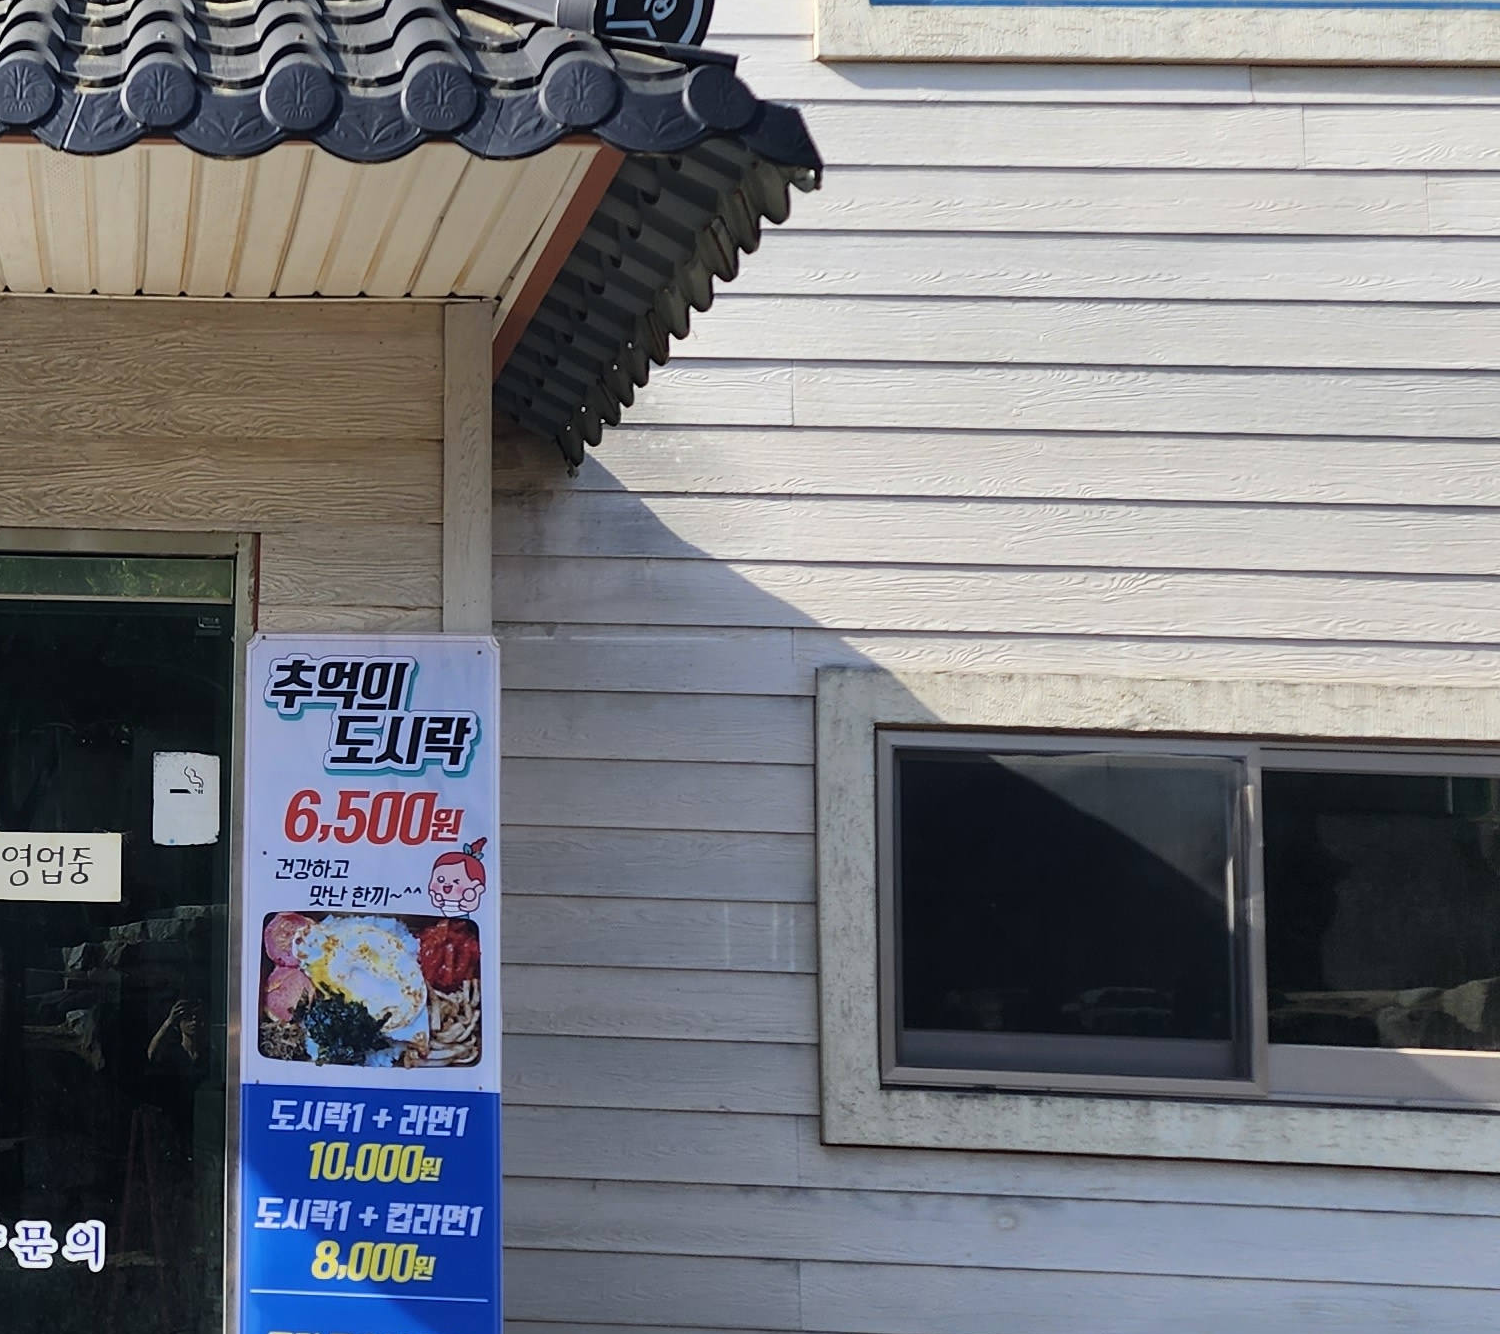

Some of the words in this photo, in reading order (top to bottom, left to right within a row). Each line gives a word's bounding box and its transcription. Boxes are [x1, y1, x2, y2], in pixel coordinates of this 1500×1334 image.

[270, 659, 409, 711] 추억의
[330, 714, 472, 766] 도시락
[284, 789, 465, 846] 6,500원
[0, 845, 95, 886] 영업중
[274, 858, 350, 880] 건강하고
[309, 885, 348, 907] 맛난
[268, 1099, 365, 1133] 도시락1
[372, 1109, 393, 1130] +
[398, 1104, 470, 1137] 라면1
[308, 1140, 443, 1184] 10,000원
[254, 1197, 351, 1232] 도시락1
[358, 1208, 379, 1229] +
[385, 1202, 484, 1237] 컵라면1
[310, 1240, 437, 1284] 8,000원
